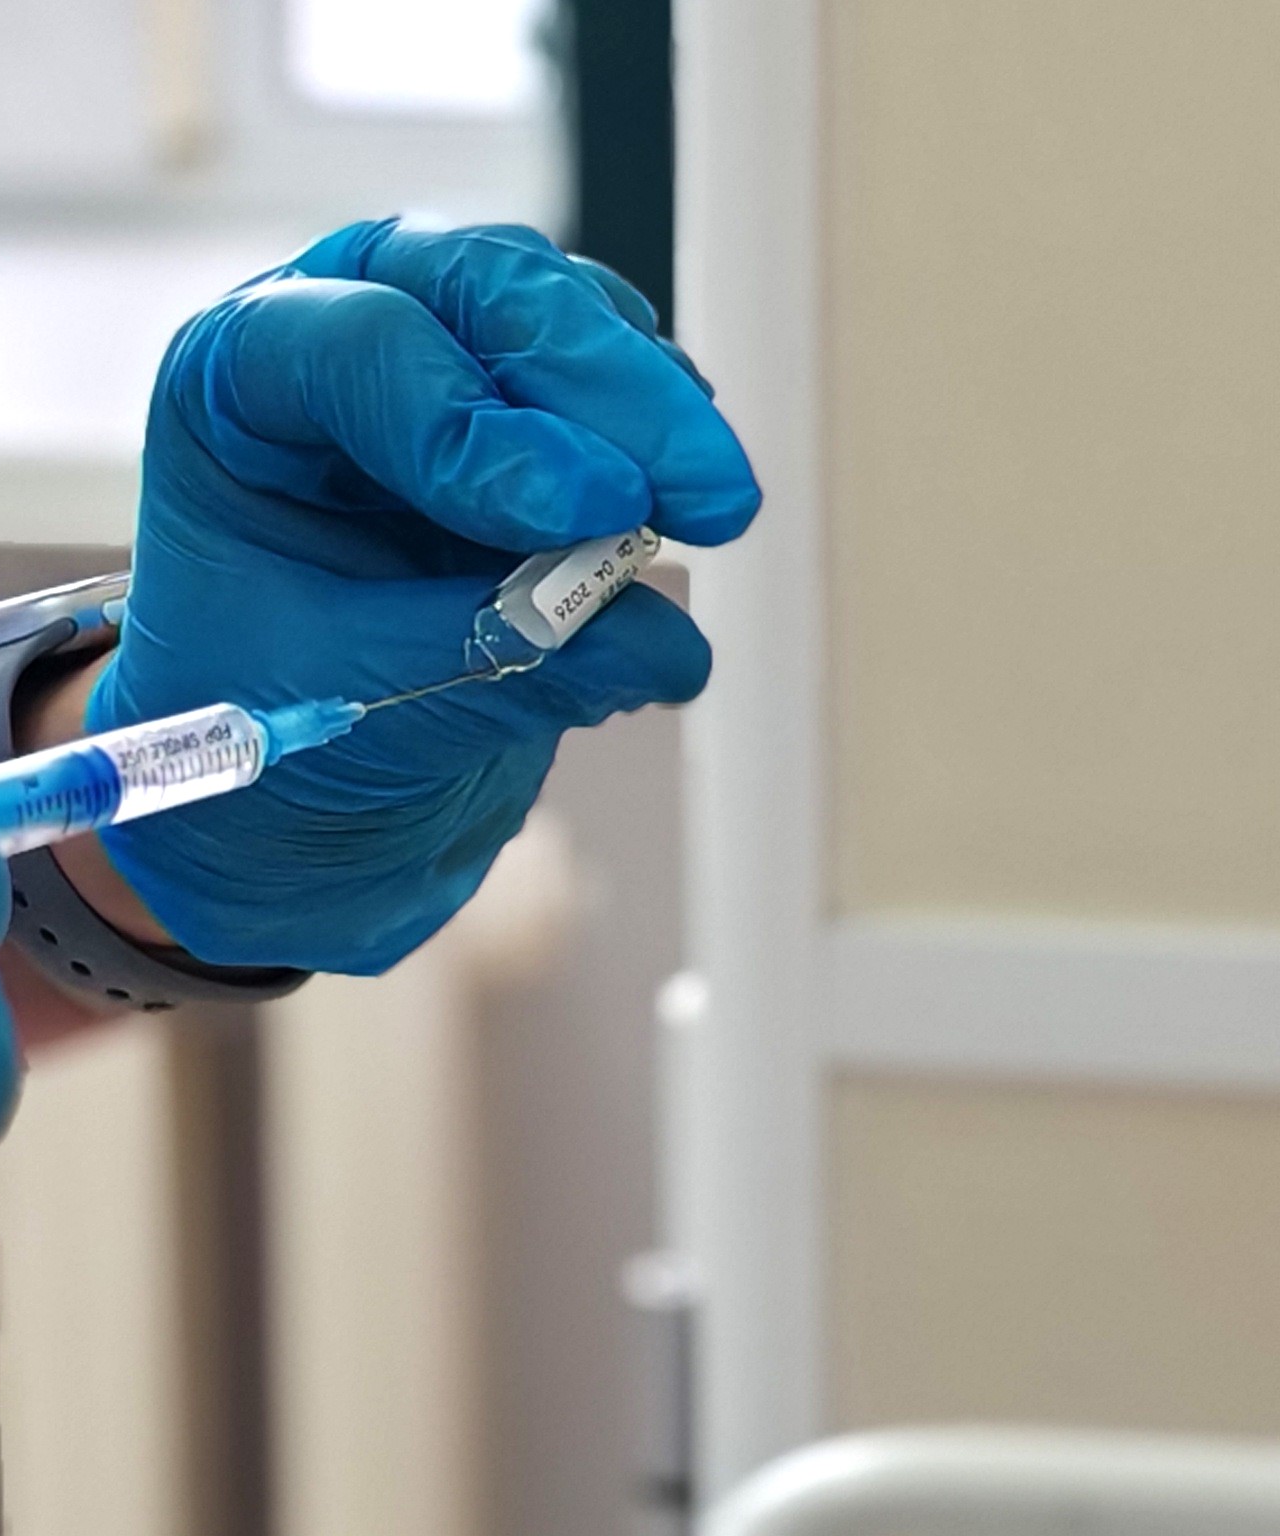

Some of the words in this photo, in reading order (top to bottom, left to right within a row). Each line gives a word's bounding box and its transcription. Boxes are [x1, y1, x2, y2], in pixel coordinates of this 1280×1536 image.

[594, 559, 614, 581] 04
[554, 582, 591, 621] 2026
[118, 748, 147, 769] USE
[151, 732, 200, 760] SINGLE
